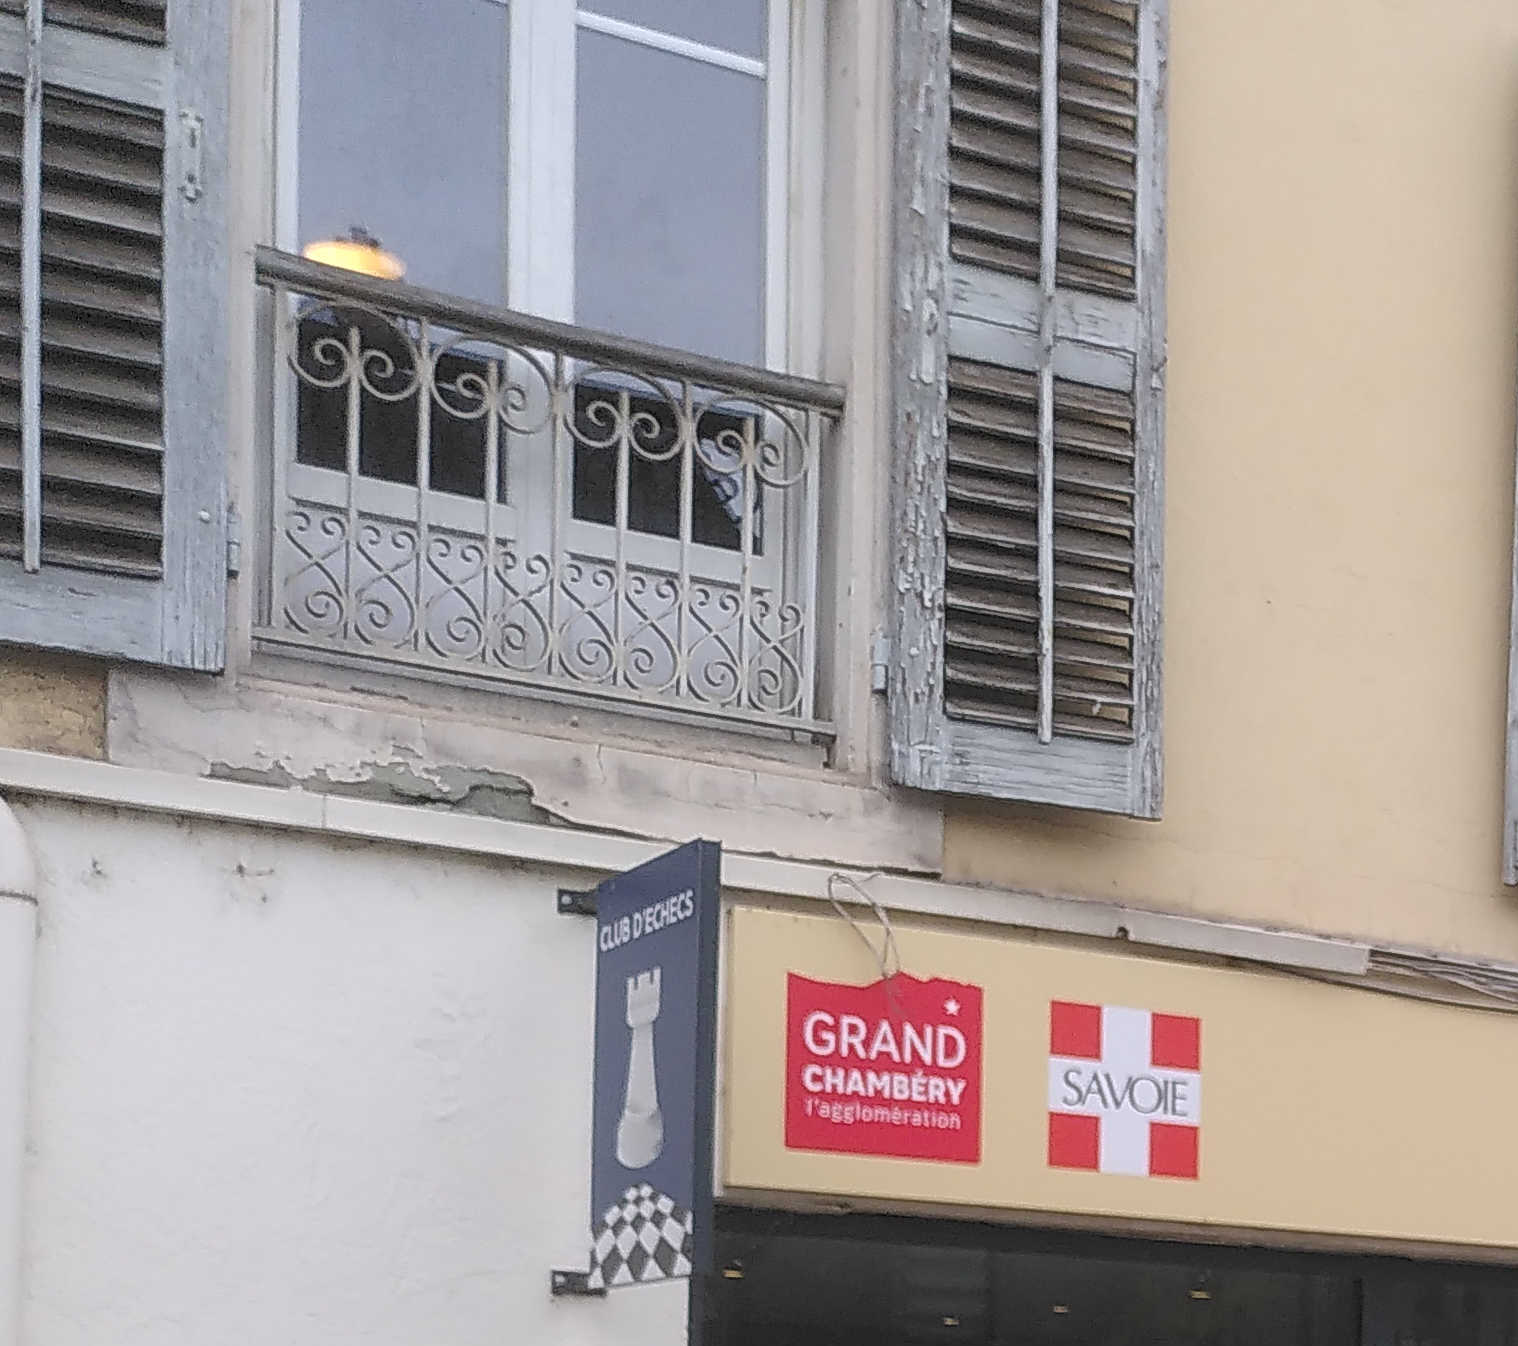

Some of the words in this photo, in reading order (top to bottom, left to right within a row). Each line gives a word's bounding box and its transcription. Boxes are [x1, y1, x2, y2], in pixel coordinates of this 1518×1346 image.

[600, 916, 630, 952] CLUB
[633, 889, 693, 939] D'ECHECS
[803, 1010, 967, 1068] GRAND
[802, 1064, 967, 1105] CHAMBÉRY
[1062, 1067, 1188, 1117] SAVOIE
[805, 1099, 961, 1130] l'agglomération
